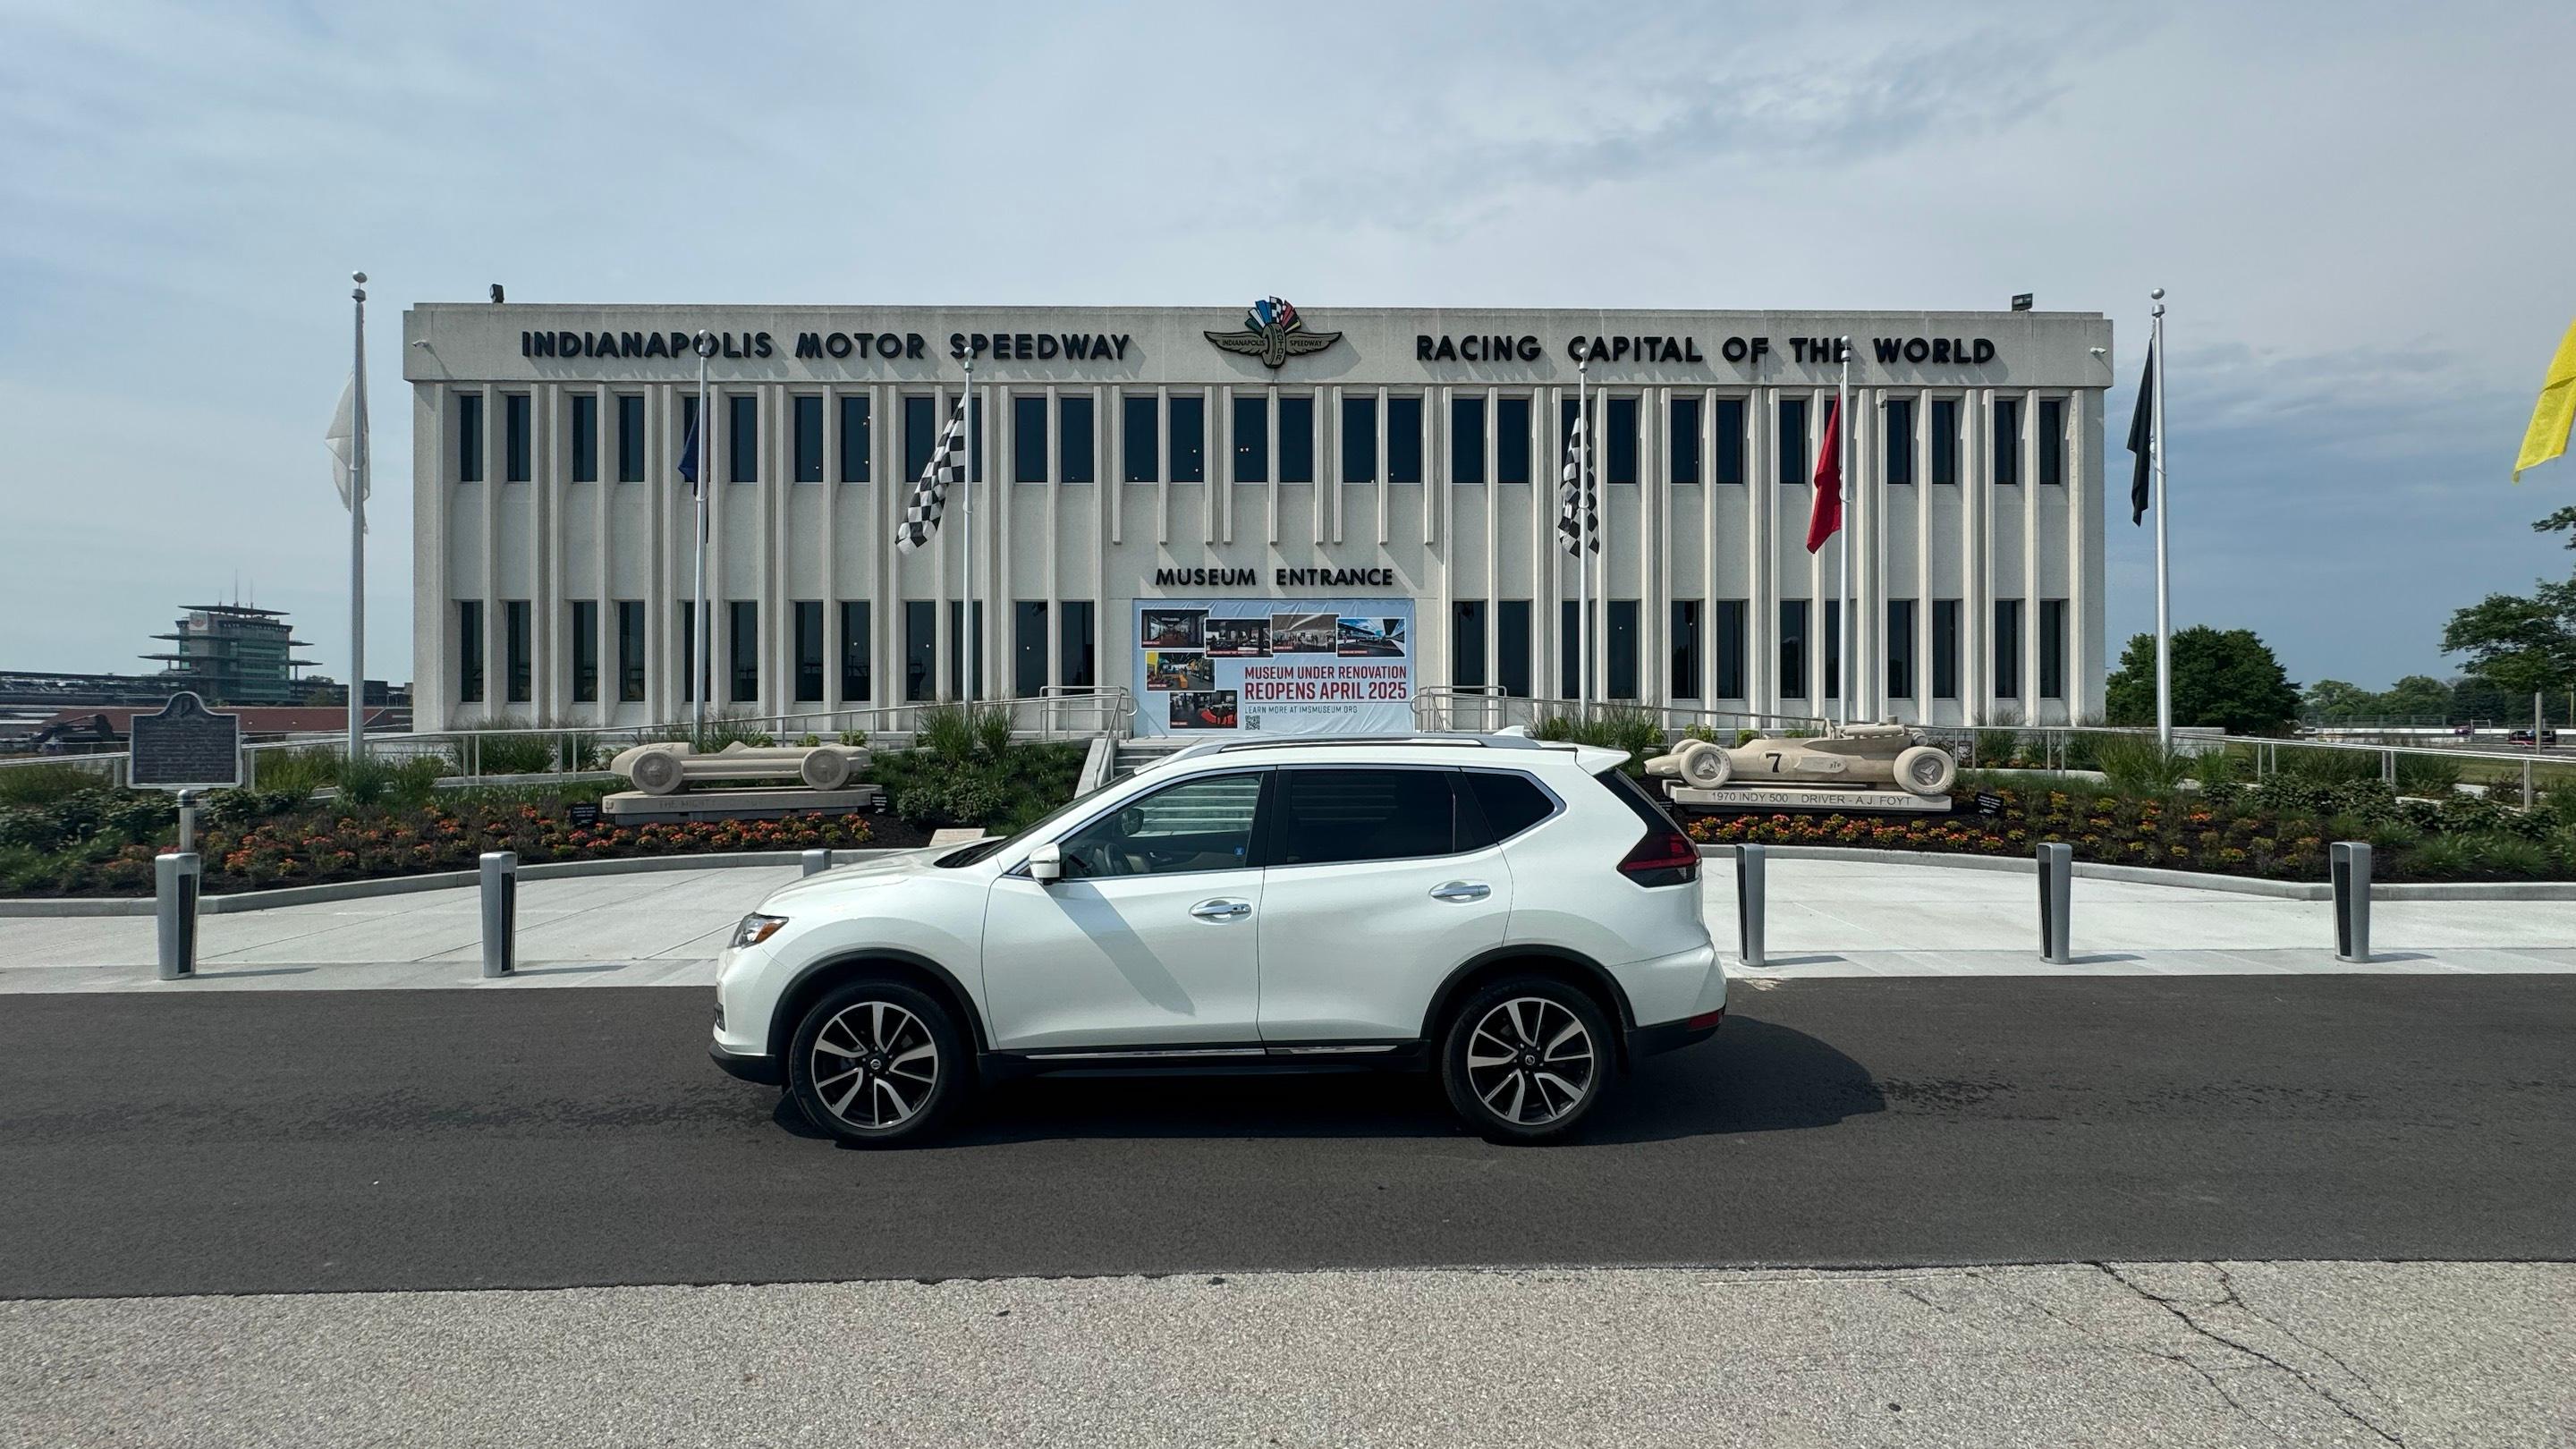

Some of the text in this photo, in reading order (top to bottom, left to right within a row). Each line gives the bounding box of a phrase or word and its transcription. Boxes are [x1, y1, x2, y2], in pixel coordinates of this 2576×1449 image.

[522, 332, 1130, 360] INDIANAPOLIS MOTOR SPEEDWAY
[1275, 328, 1284, 361] MOTOR
[1290, 339, 1323, 347] SPEEDWAY
[1417, 335, 1541, 361] RACING
[1567, 336, 1702, 362] CAPITAL
[1723, 337, 1768, 363] OF
[1873, 338, 1996, 366] WORLD
[1155, 568, 1393, 587] MUSEUM ENTRANCE
[1244, 665, 1407, 680] MUSEUM UNDER RENOVATION
[1244, 682, 1407, 700] REOPENS APRIL 2025
[1268, 706, 1288, 714] MORE
[1290, 706, 1298, 714] AT
[1766, 752, 1783, 774] 7
[1712, 792, 1736, 801] 1970
[1739, 792, 1767, 802] INDY
[1769, 793, 1789, 802] 500
[1801, 794, 1846, 804] DRIVER
[1879, 796, 1911, 806] FOYT
